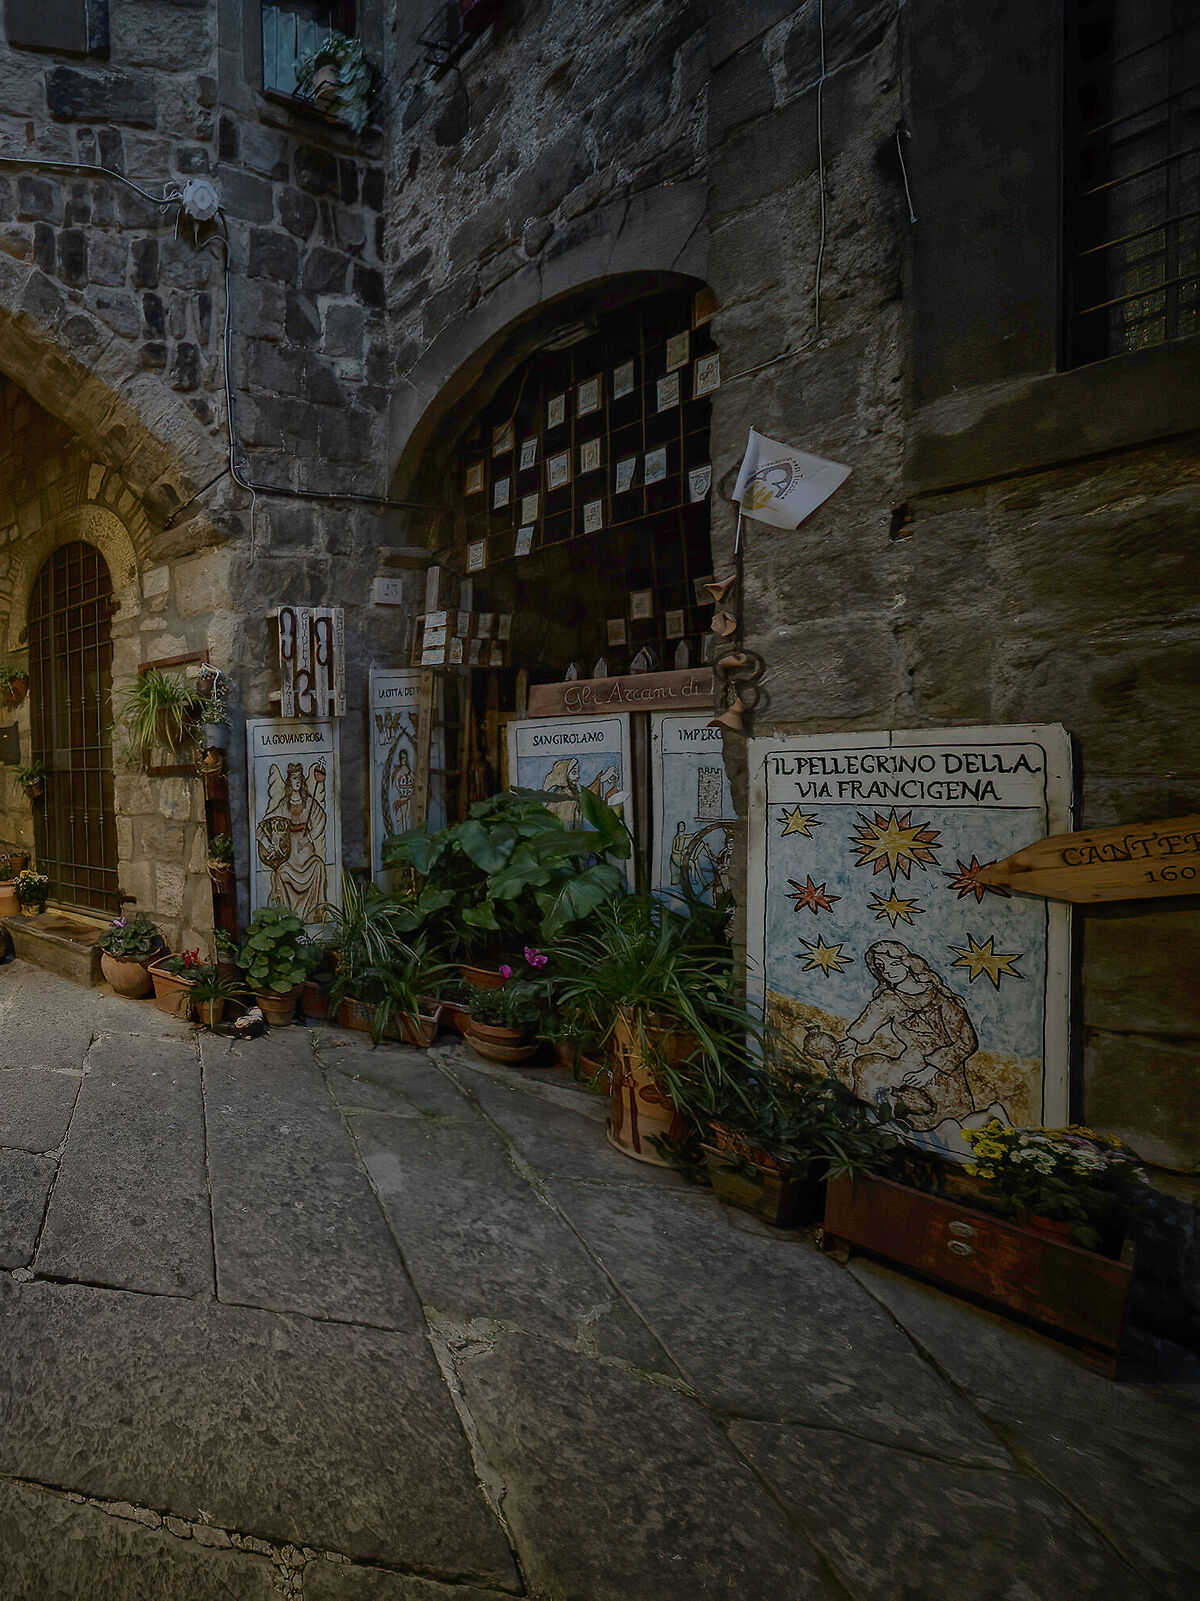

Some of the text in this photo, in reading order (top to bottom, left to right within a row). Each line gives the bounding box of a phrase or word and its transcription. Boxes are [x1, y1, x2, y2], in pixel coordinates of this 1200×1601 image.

[564, 684, 602, 713] Gli
[604, 682, 677, 705] Arcani
[681, 677, 701, 697] di
[772, 753, 1042, 776] IL PELLEGRINO DELLA
[795, 778, 1002, 801] VIA FRANCIGENA
